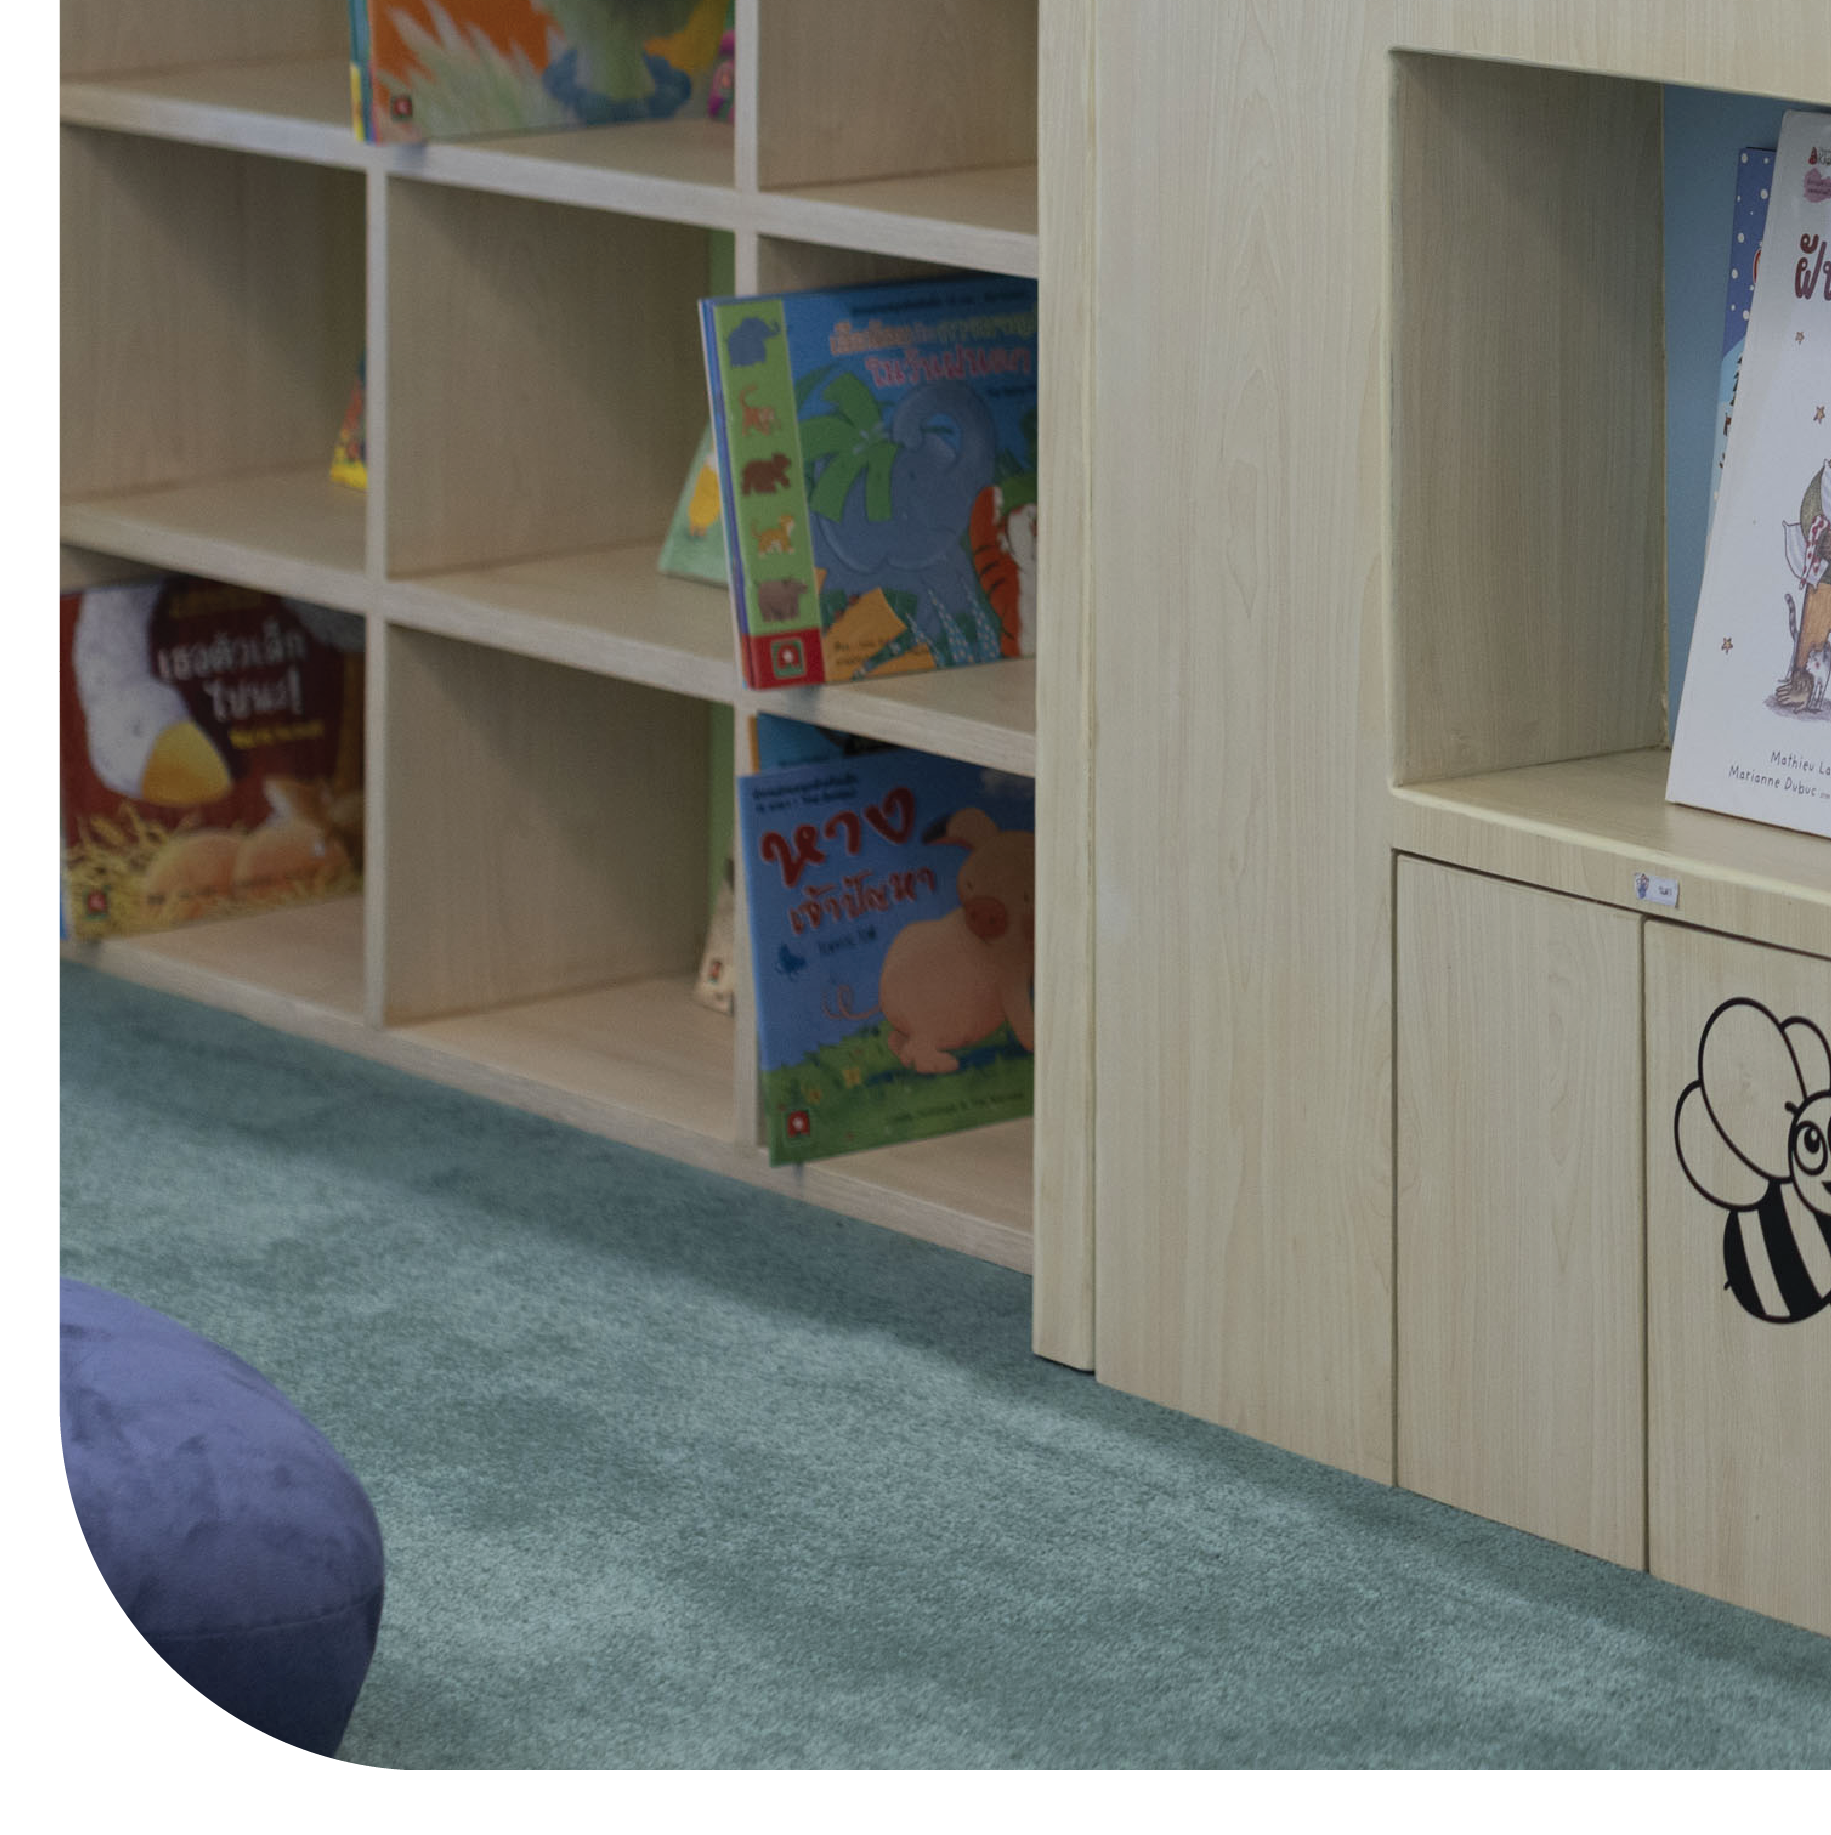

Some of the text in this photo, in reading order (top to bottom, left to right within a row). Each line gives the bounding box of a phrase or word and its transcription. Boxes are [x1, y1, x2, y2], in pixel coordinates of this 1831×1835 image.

[1728, 764, 1781, 789] Marianne
[1770, 750, 1815, 773] Mathieu
[761, 785, 916, 888] หาง
[789, 868, 937, 935] เจ้าปัญหา
